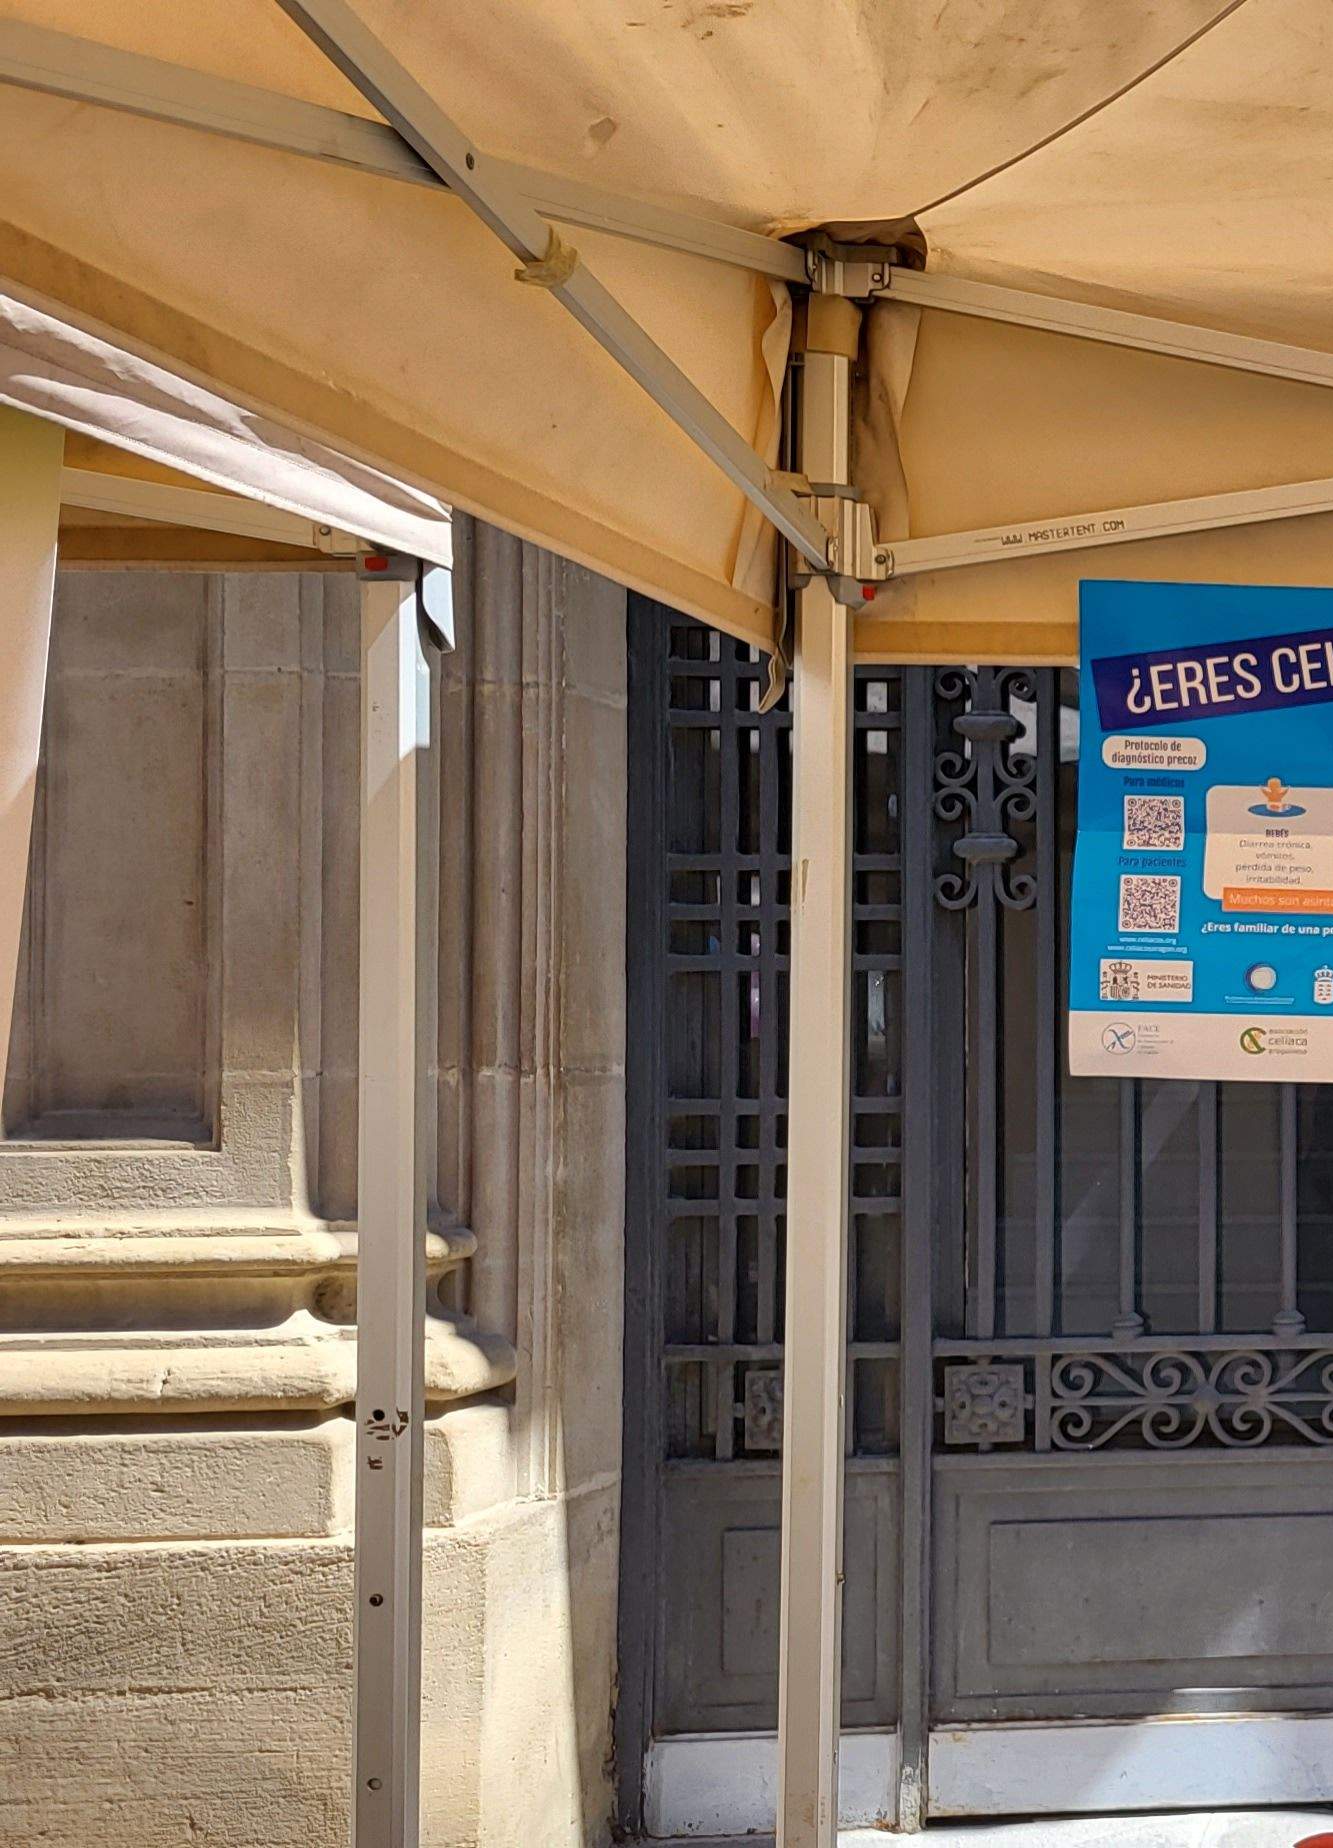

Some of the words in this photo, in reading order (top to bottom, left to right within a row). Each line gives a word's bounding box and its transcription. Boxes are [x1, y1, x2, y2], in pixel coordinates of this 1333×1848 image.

[1126, 653, 1261, 714] ¿ERES
[1125, 740, 1168, 751] Protocolo
[1170, 741, 1182, 751] de
[1112, 751, 1164, 765] diagnóstico
[1167, 755, 1197, 767] precoz
[1118, 856, 1138, 866] Para
[1230, 894, 1275, 906] Muchos
[1278, 897, 1299, 906] son
[1201, 923, 1231, 934] ¿Eres
[1234, 923, 1278, 934] familiar
[1281, 924, 1296, 934] de
[1298, 926, 1320, 935] una
